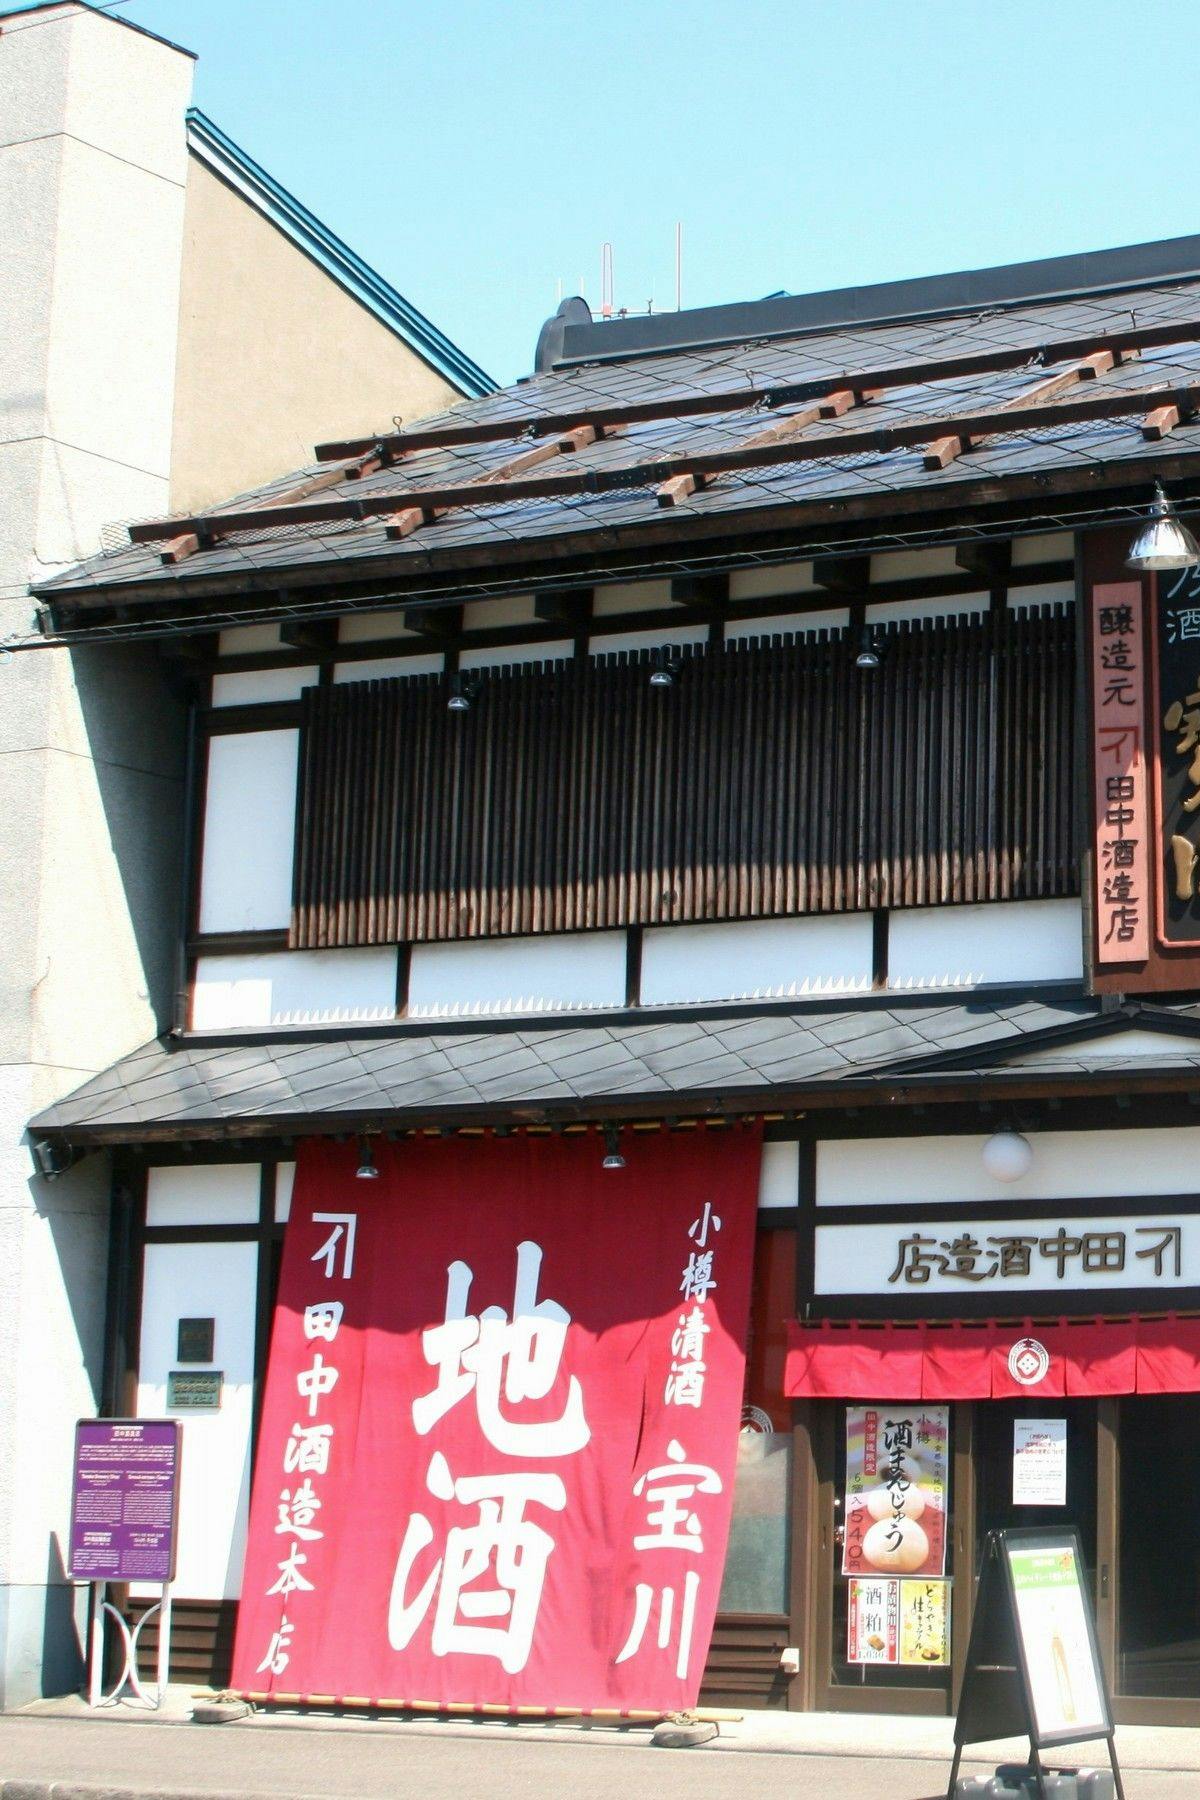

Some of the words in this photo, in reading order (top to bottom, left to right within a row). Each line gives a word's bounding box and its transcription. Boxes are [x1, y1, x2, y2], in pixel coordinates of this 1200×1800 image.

[1102, 776, 1138, 945] 田中酒造店
[663, 1201, 722, 1409] 小樽清酒
[255, 1301, 345, 1676] 田中酒造本店
[387, 1239, 592, 1676] 地酒
[614, 1438, 723, 1680] 宝川
